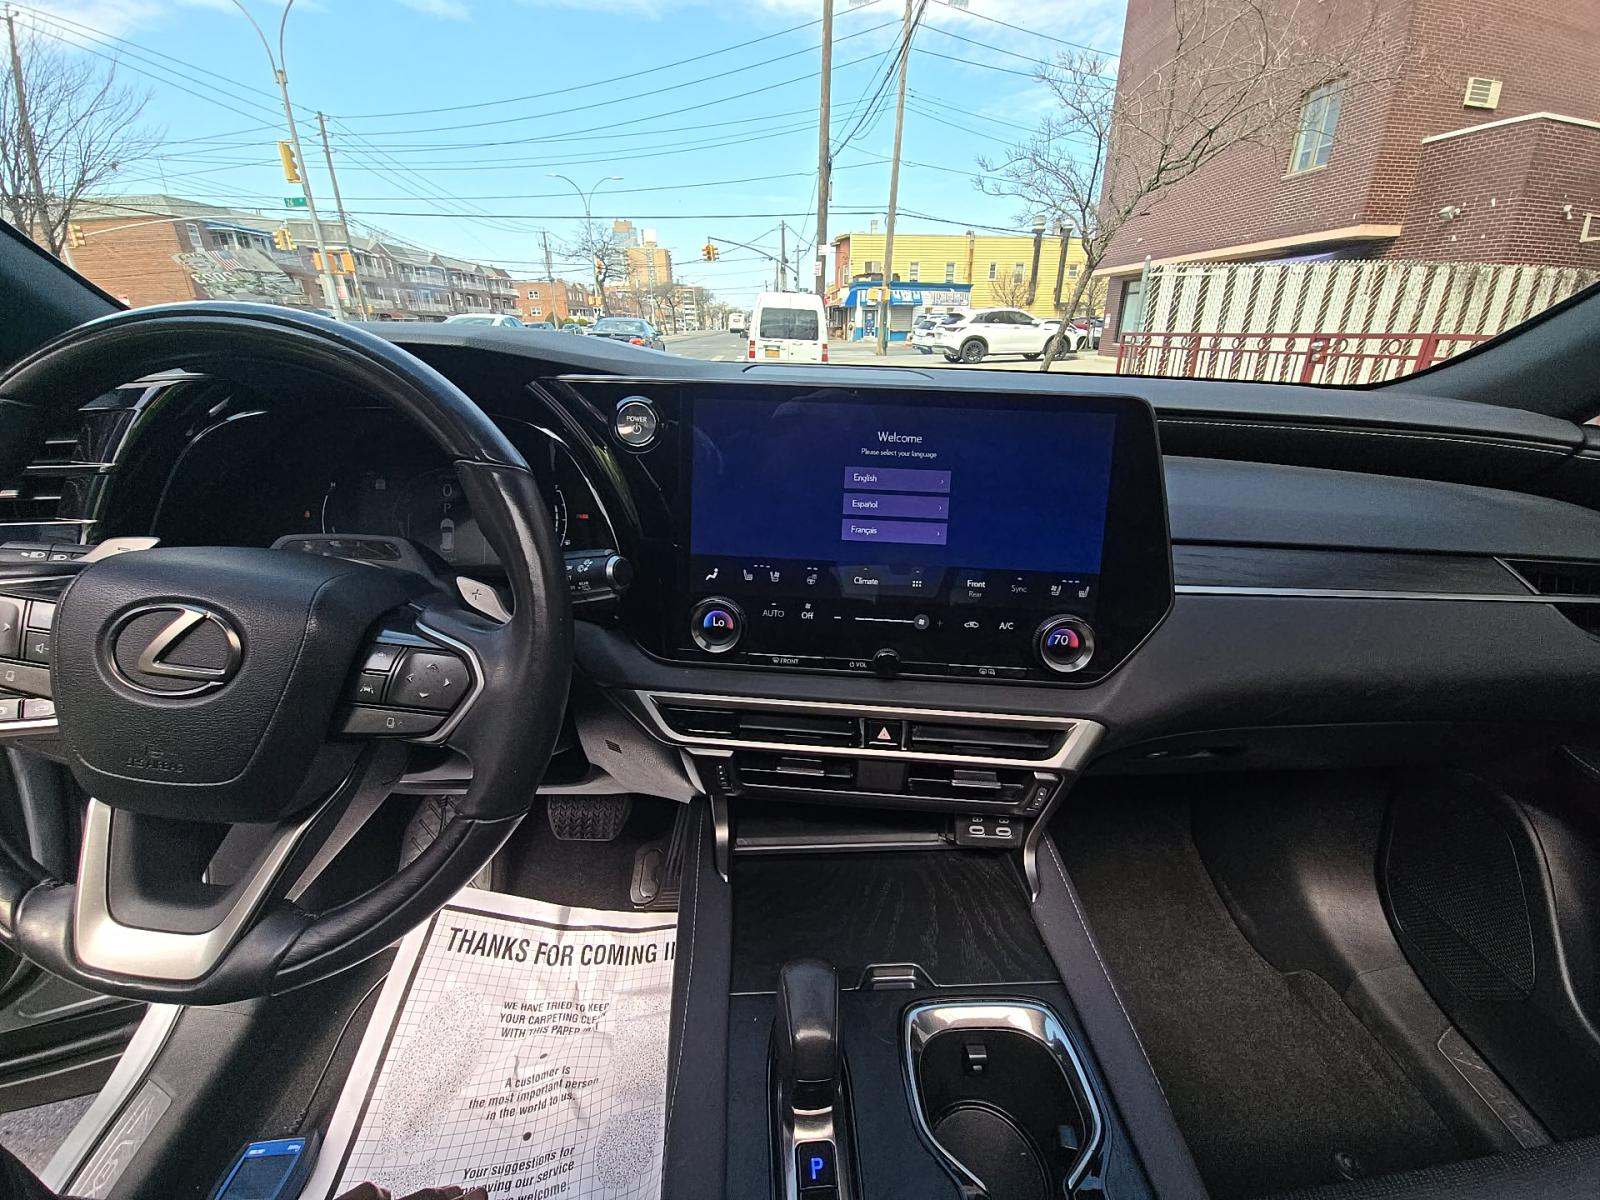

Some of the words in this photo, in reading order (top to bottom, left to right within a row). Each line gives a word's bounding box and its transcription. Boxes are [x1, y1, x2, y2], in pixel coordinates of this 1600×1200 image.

[626, 415, 648, 423] POWER
[877, 431, 923, 444] Welcome
[861, 447, 880, 456] Please
[880, 449, 897, 457] select
[898, 451, 910, 459] your
[911, 450, 937, 459] language
[853, 473, 878, 484] English
[852, 499, 878, 510] Español
[850, 525, 878, 535] Français
[853, 576, 879, 586] Climate
[966, 579, 986, 589] Front
[968, 590, 982, 598] Rear
[1011, 584, 1028, 594] Sync
[761, 608, 785, 618] AUTO
[801, 611, 814, 620] Off
[712, 617, 725, 628] Lo
[998, 621, 1015, 631] A/C
[1054, 634, 1069, 646] 70
[779, 657, 800, 665] FRONT
[855, 661, 868, 669] VOL
[447, 926, 530, 963] THANKS
[533, 942, 574, 967] FOR
[580, 943, 658, 966] COMING
[504, 1001, 518, 1010] WE
[520, 1002, 544, 1013] HAVE
[546, 1001, 573, 1011] TRIED
[575, 1003, 586, 1013] TO
[500, 1013, 526, 1025] YOUR
[528, 1012, 579, 1025] CARPETING
[501, 1027, 526, 1038] WITH
[529, 1025, 549, 1036] THIS
[504, 1077, 512, 1088] A
[514, 1067, 560, 1088] customer
[562, 1065, 571, 1075] is
[468, 1098, 486, 1109] the
[488, 1092, 515, 1107] most
[516, 1078, 563, 1102] important
[564, 1077, 599, 1090] person
[485, 1110, 497, 1121] in
[499, 1106, 516, 1119] the
[519, 1098, 547, 1116] world
[549, 1095, 558, 1106] to
[463, 1167, 489, 1181] Your
[491, 1149, 557, 1177] suggestions
[559, 1145, 576, 1159] for
[810, 1157, 824, 1180] P
[515, 1176, 534, 1189] our
[537, 1160, 575, 1183] service
